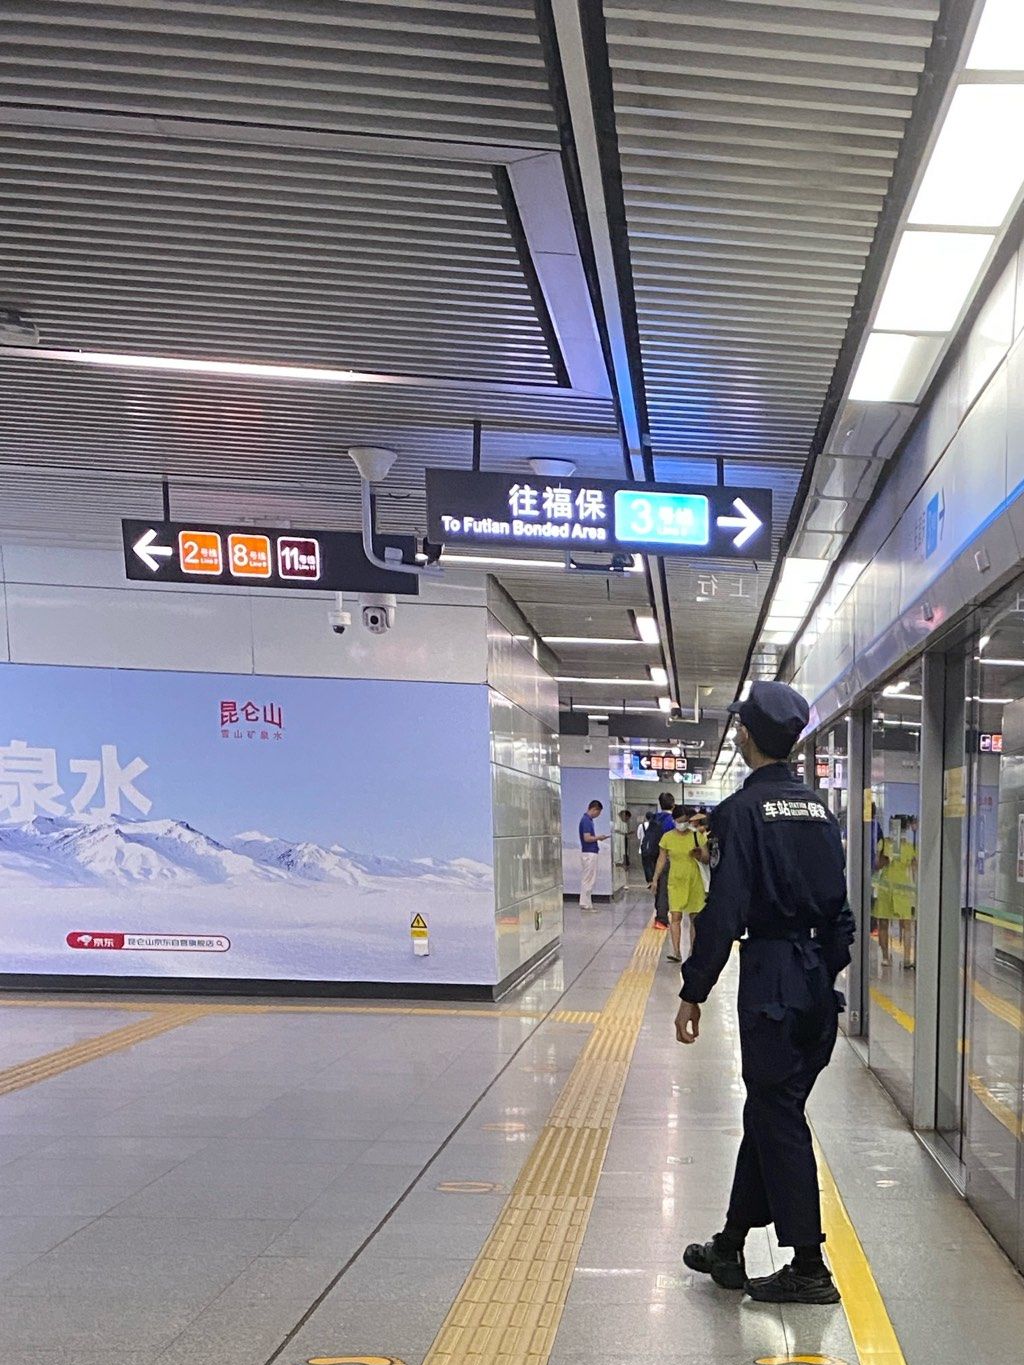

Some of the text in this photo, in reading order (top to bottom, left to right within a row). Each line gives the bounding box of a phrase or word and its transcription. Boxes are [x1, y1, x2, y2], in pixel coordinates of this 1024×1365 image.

[508, 483, 607, 521] 往福保
[441, 515, 606, 540] To Futian Bonded Area
[629, 499, 654, 535] 3
[183, 541, 200, 564] 2
[233, 543, 248, 567] 8
[281, 547, 299, 571] 11
[220, 700, 283, 729] 昆仑山
[221, 729, 283, 741] 雪山矿泉水
[0, 739, 153, 825] 泉水
[763, 800, 791, 818] 车站
[93, 938, 114, 948] 京东
